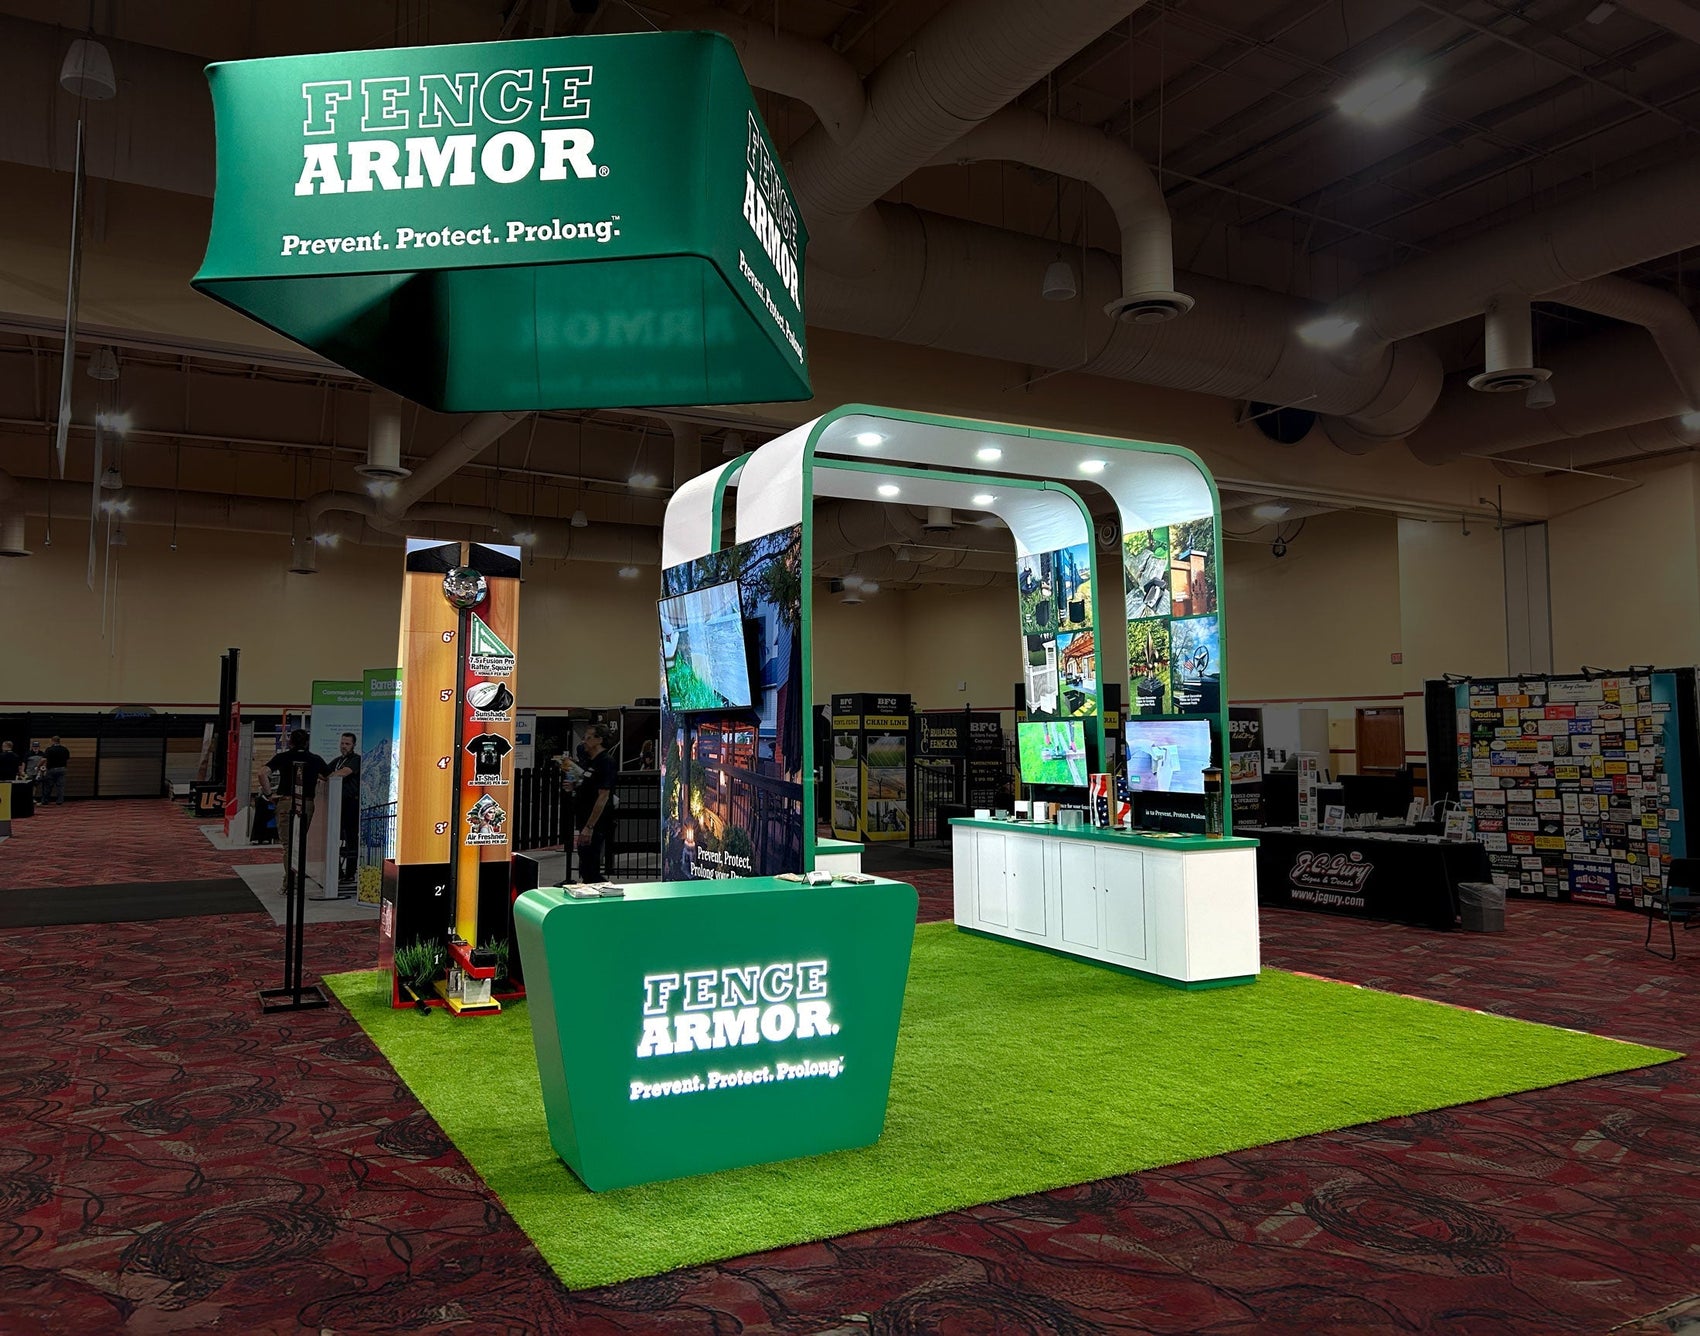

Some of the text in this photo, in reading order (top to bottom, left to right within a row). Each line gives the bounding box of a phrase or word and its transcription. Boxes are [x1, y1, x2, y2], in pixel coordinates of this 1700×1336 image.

[302, 65, 594, 136] FENCE
[746, 109, 798, 262] FENCE
[280, 230, 390, 257] Prevent.
[395, 224, 501, 250] Protect.
[743, 168, 802, 313] ARMOR
[491, 664, 513, 672] Square
[475, 710, 506, 718] Sunshade
[929, 727, 958, 737] BUILDERS
[969, 722, 998, 732] BFC
[1229, 719, 1260, 733] BFC
[929, 739, 958, 749] FENCE CO
[1155, 810, 1173, 818] Prevent,
[1173, 811, 1190, 819] Protect,
[697, 846, 752, 872] Prevent, Protect,
[690, 862, 715, 881] Prolong
[1290, 888, 1366, 908] www.jcgury.com
[642, 960, 828, 1016] FENCE
[629, 1074, 706, 1101] Prevent.
[707, 1066, 775, 1091] Protect.
